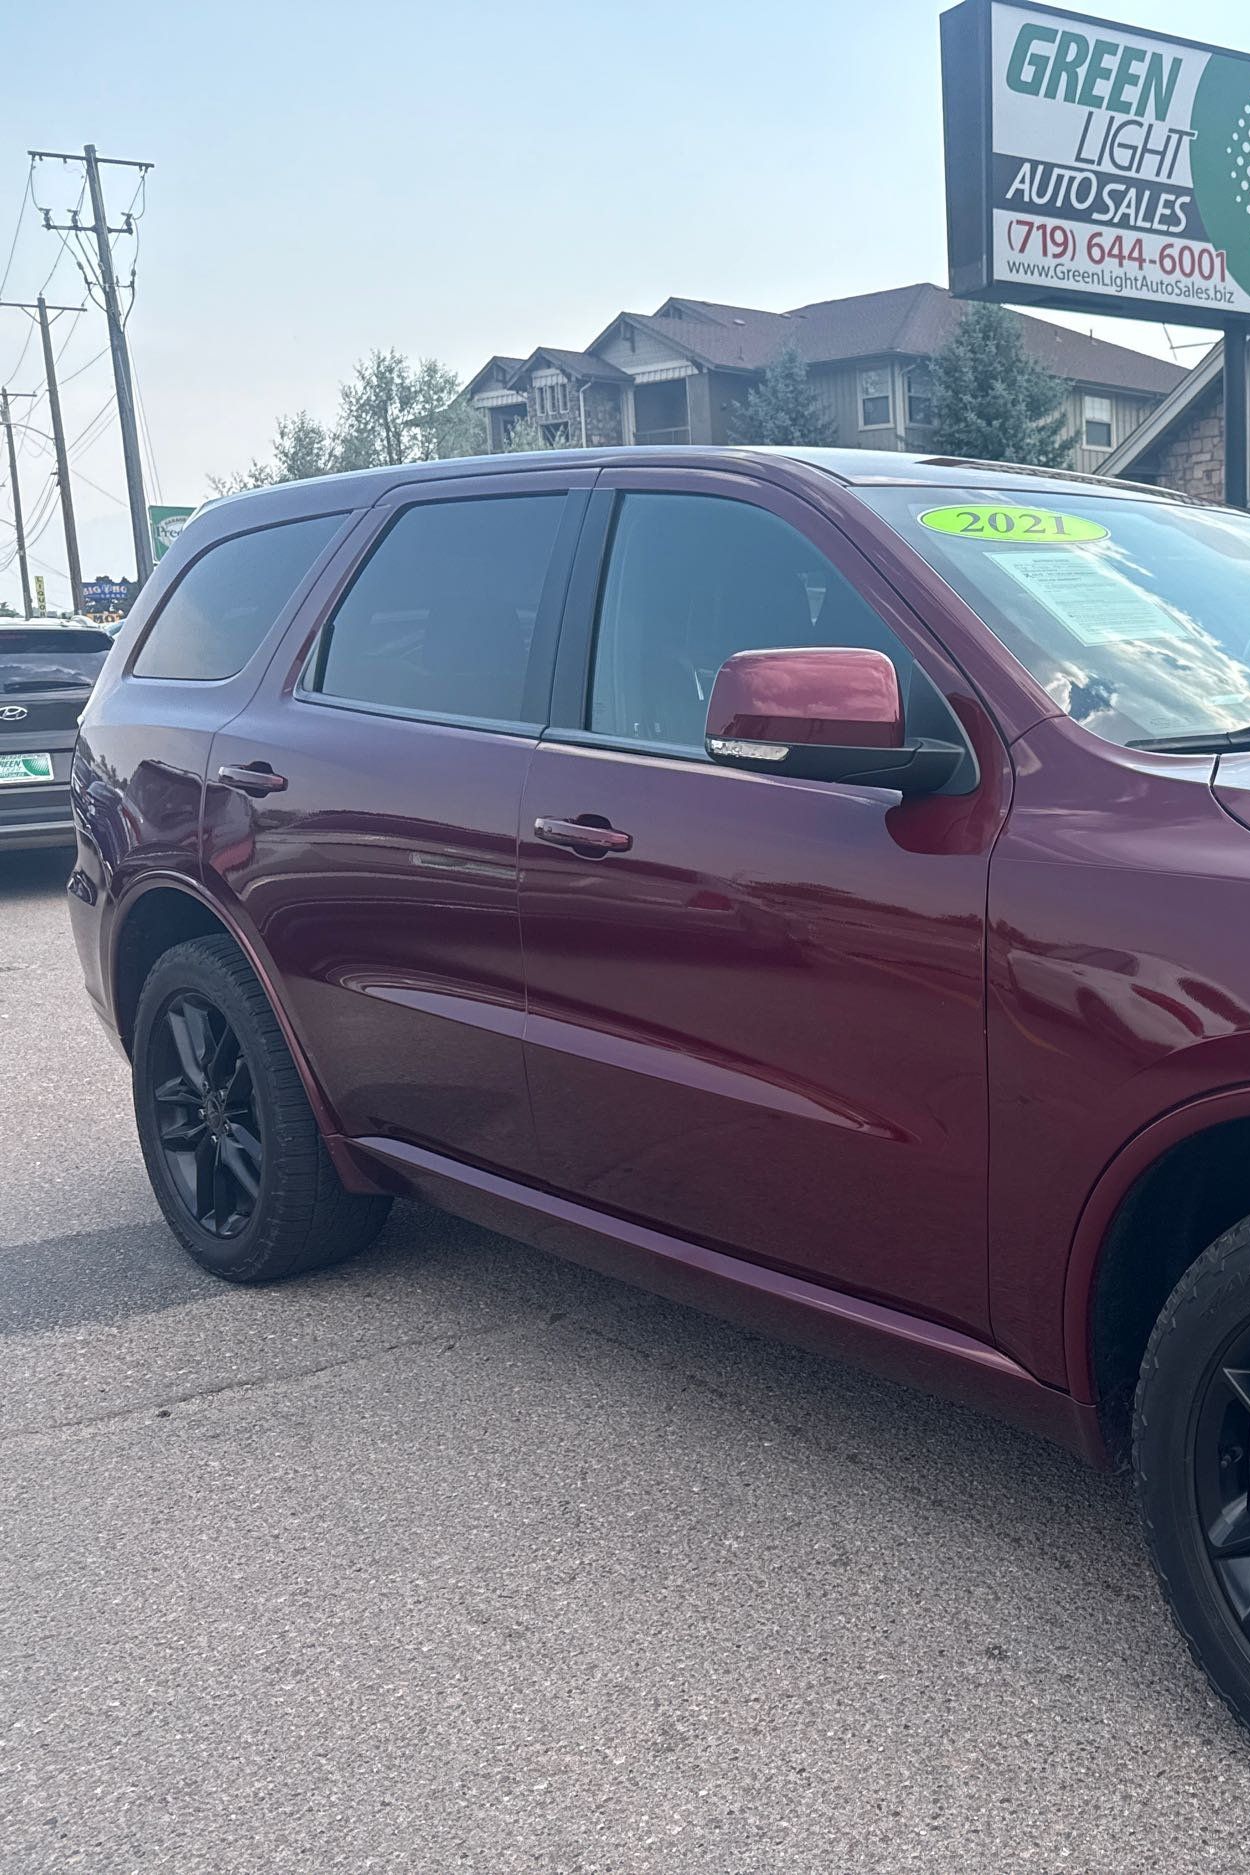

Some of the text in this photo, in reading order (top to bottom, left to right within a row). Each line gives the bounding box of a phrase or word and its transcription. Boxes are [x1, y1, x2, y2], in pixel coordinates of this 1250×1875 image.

[1005, 22, 1183, 122] GREEN
[1074, 110, 1197, 180] LIGHT
[1005, 162, 1192, 234] AUTO SALES
[1006, 218, 1228, 283] (719) 644-6001
[1006, 258, 1235, 303] www.GreenLightAutoSales.biz
[956, 511, 1071, 536] 2021
